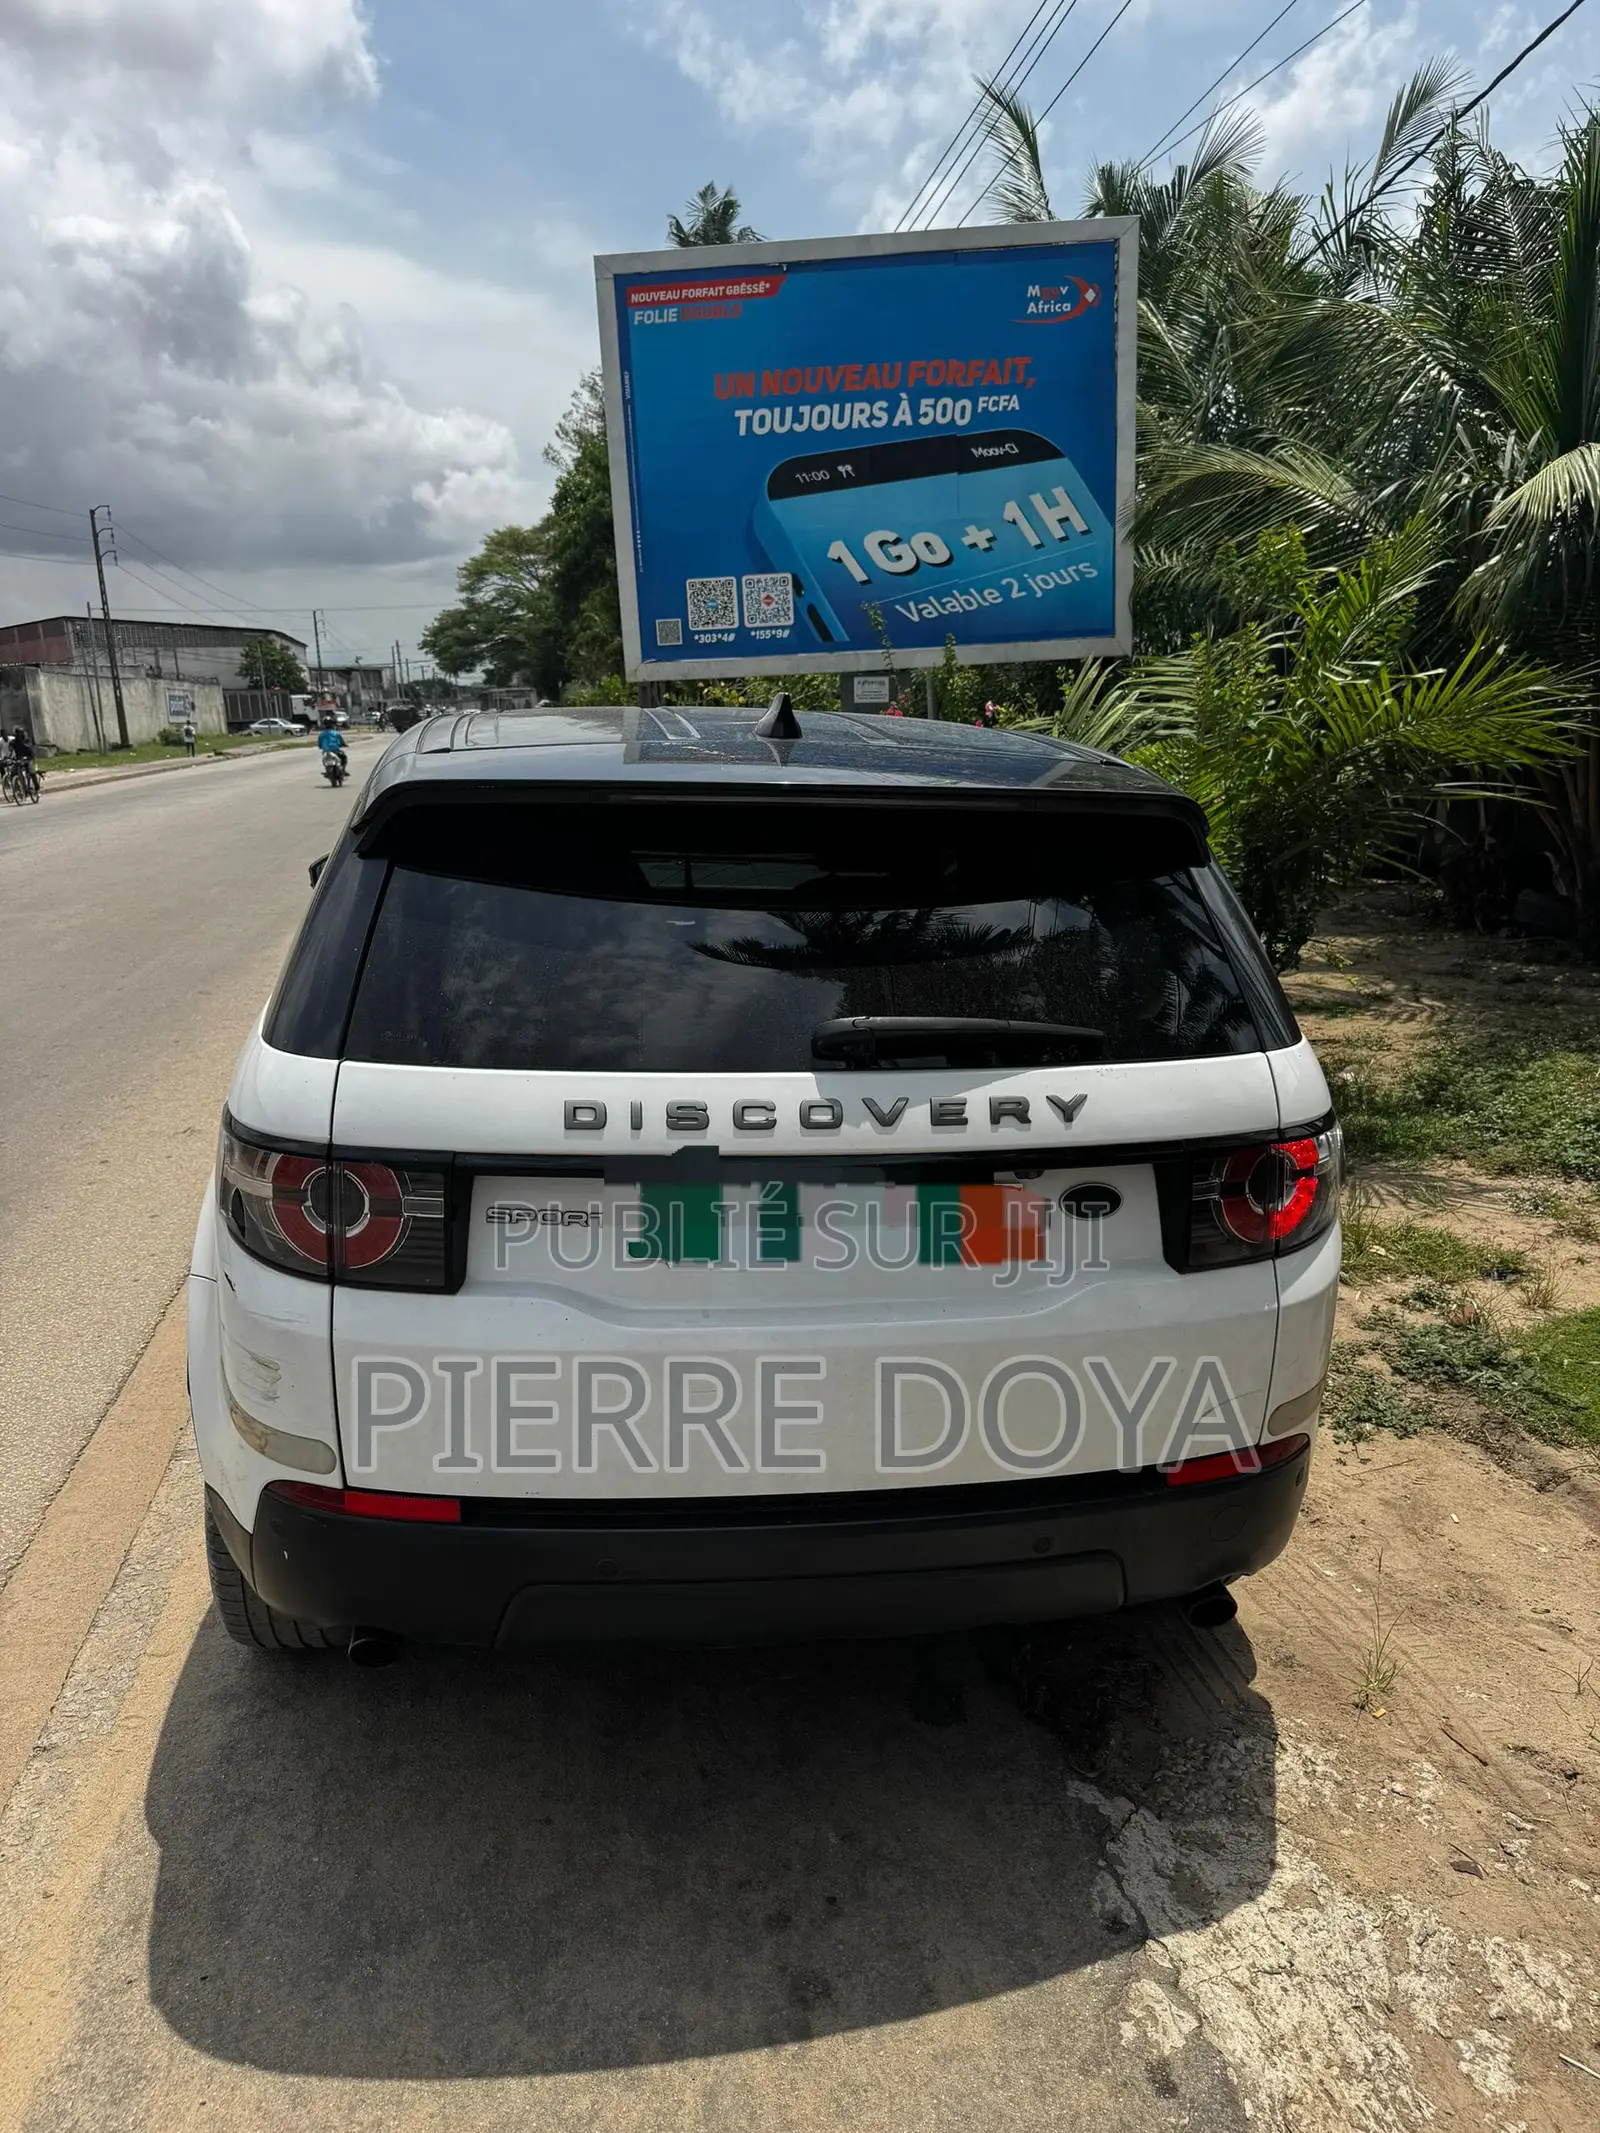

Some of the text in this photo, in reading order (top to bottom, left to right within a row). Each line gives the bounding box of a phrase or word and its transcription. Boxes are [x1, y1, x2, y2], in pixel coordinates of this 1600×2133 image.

[631, 289, 680, 303] NOUVEAU
[681, 286, 725, 299] FORFAIT
[1026, 300, 1071, 314] Africa
[634, 308, 678, 325] FOLIE
[714, 356, 1036, 399] UN NOUVEAU FORFAIT,
[734, 393, 1020, 436] TOUJOURS À 500 FCFA
[795, 469, 830, 484] 11:00
[895, 562, 1098, 624] Valable 2 jours
[564, 1093, 1088, 1130] DISCOVERY
